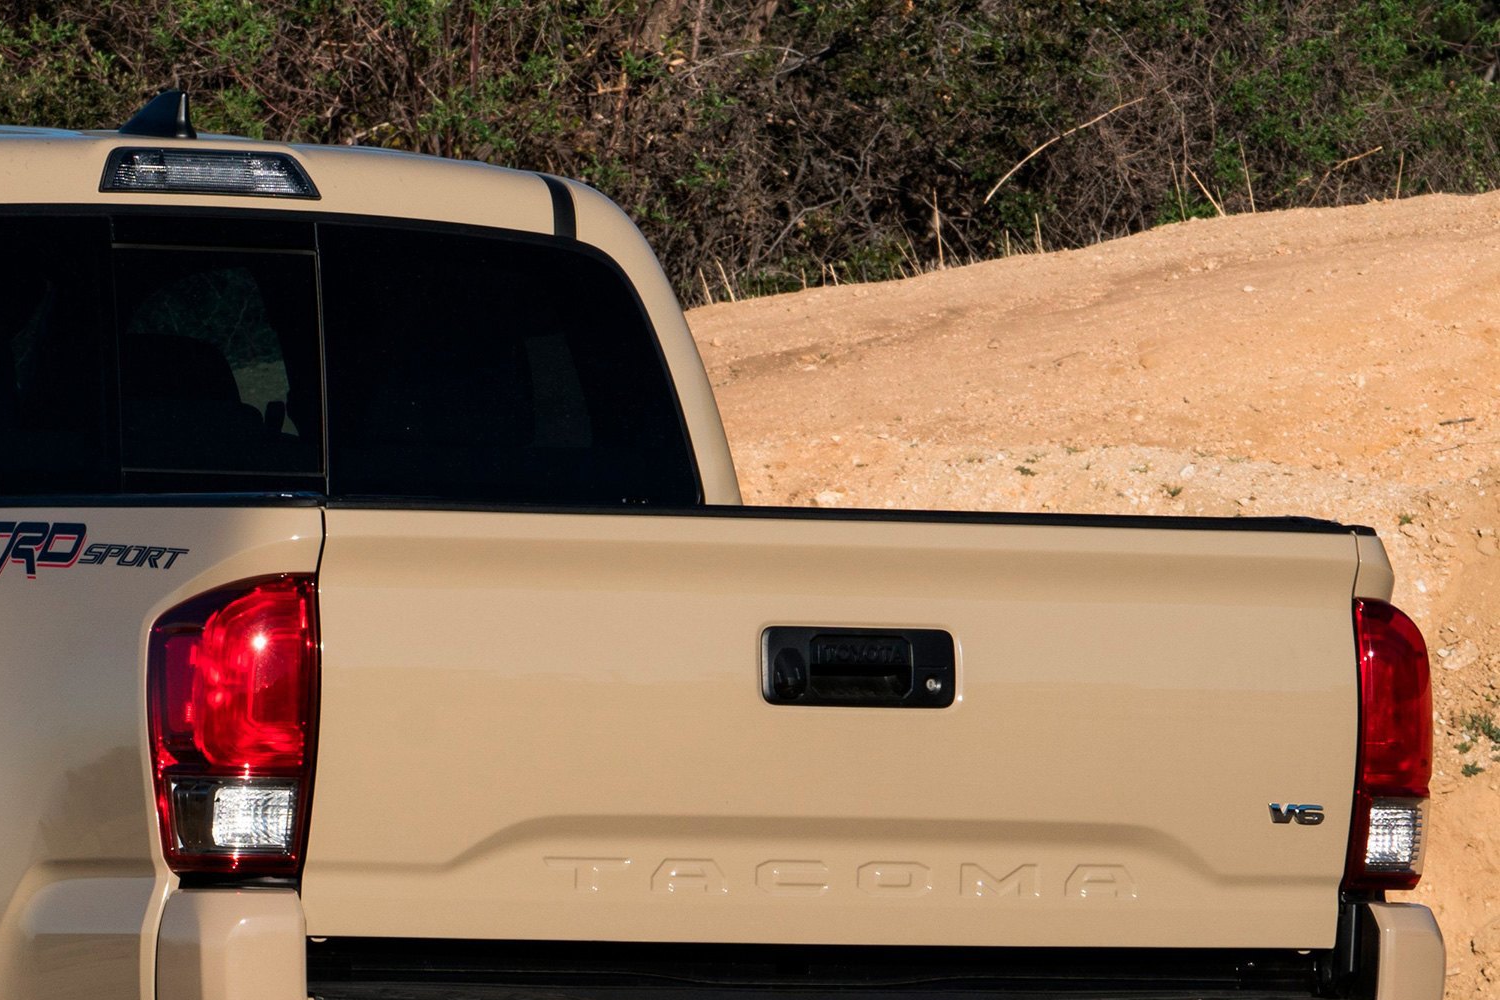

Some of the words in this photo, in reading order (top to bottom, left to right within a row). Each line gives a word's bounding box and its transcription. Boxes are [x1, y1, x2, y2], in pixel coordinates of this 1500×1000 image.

[78, 543, 190, 569] SPORT
[1268, 803, 1325, 826] V6
[543, 856, 1138, 898] TACOMA
